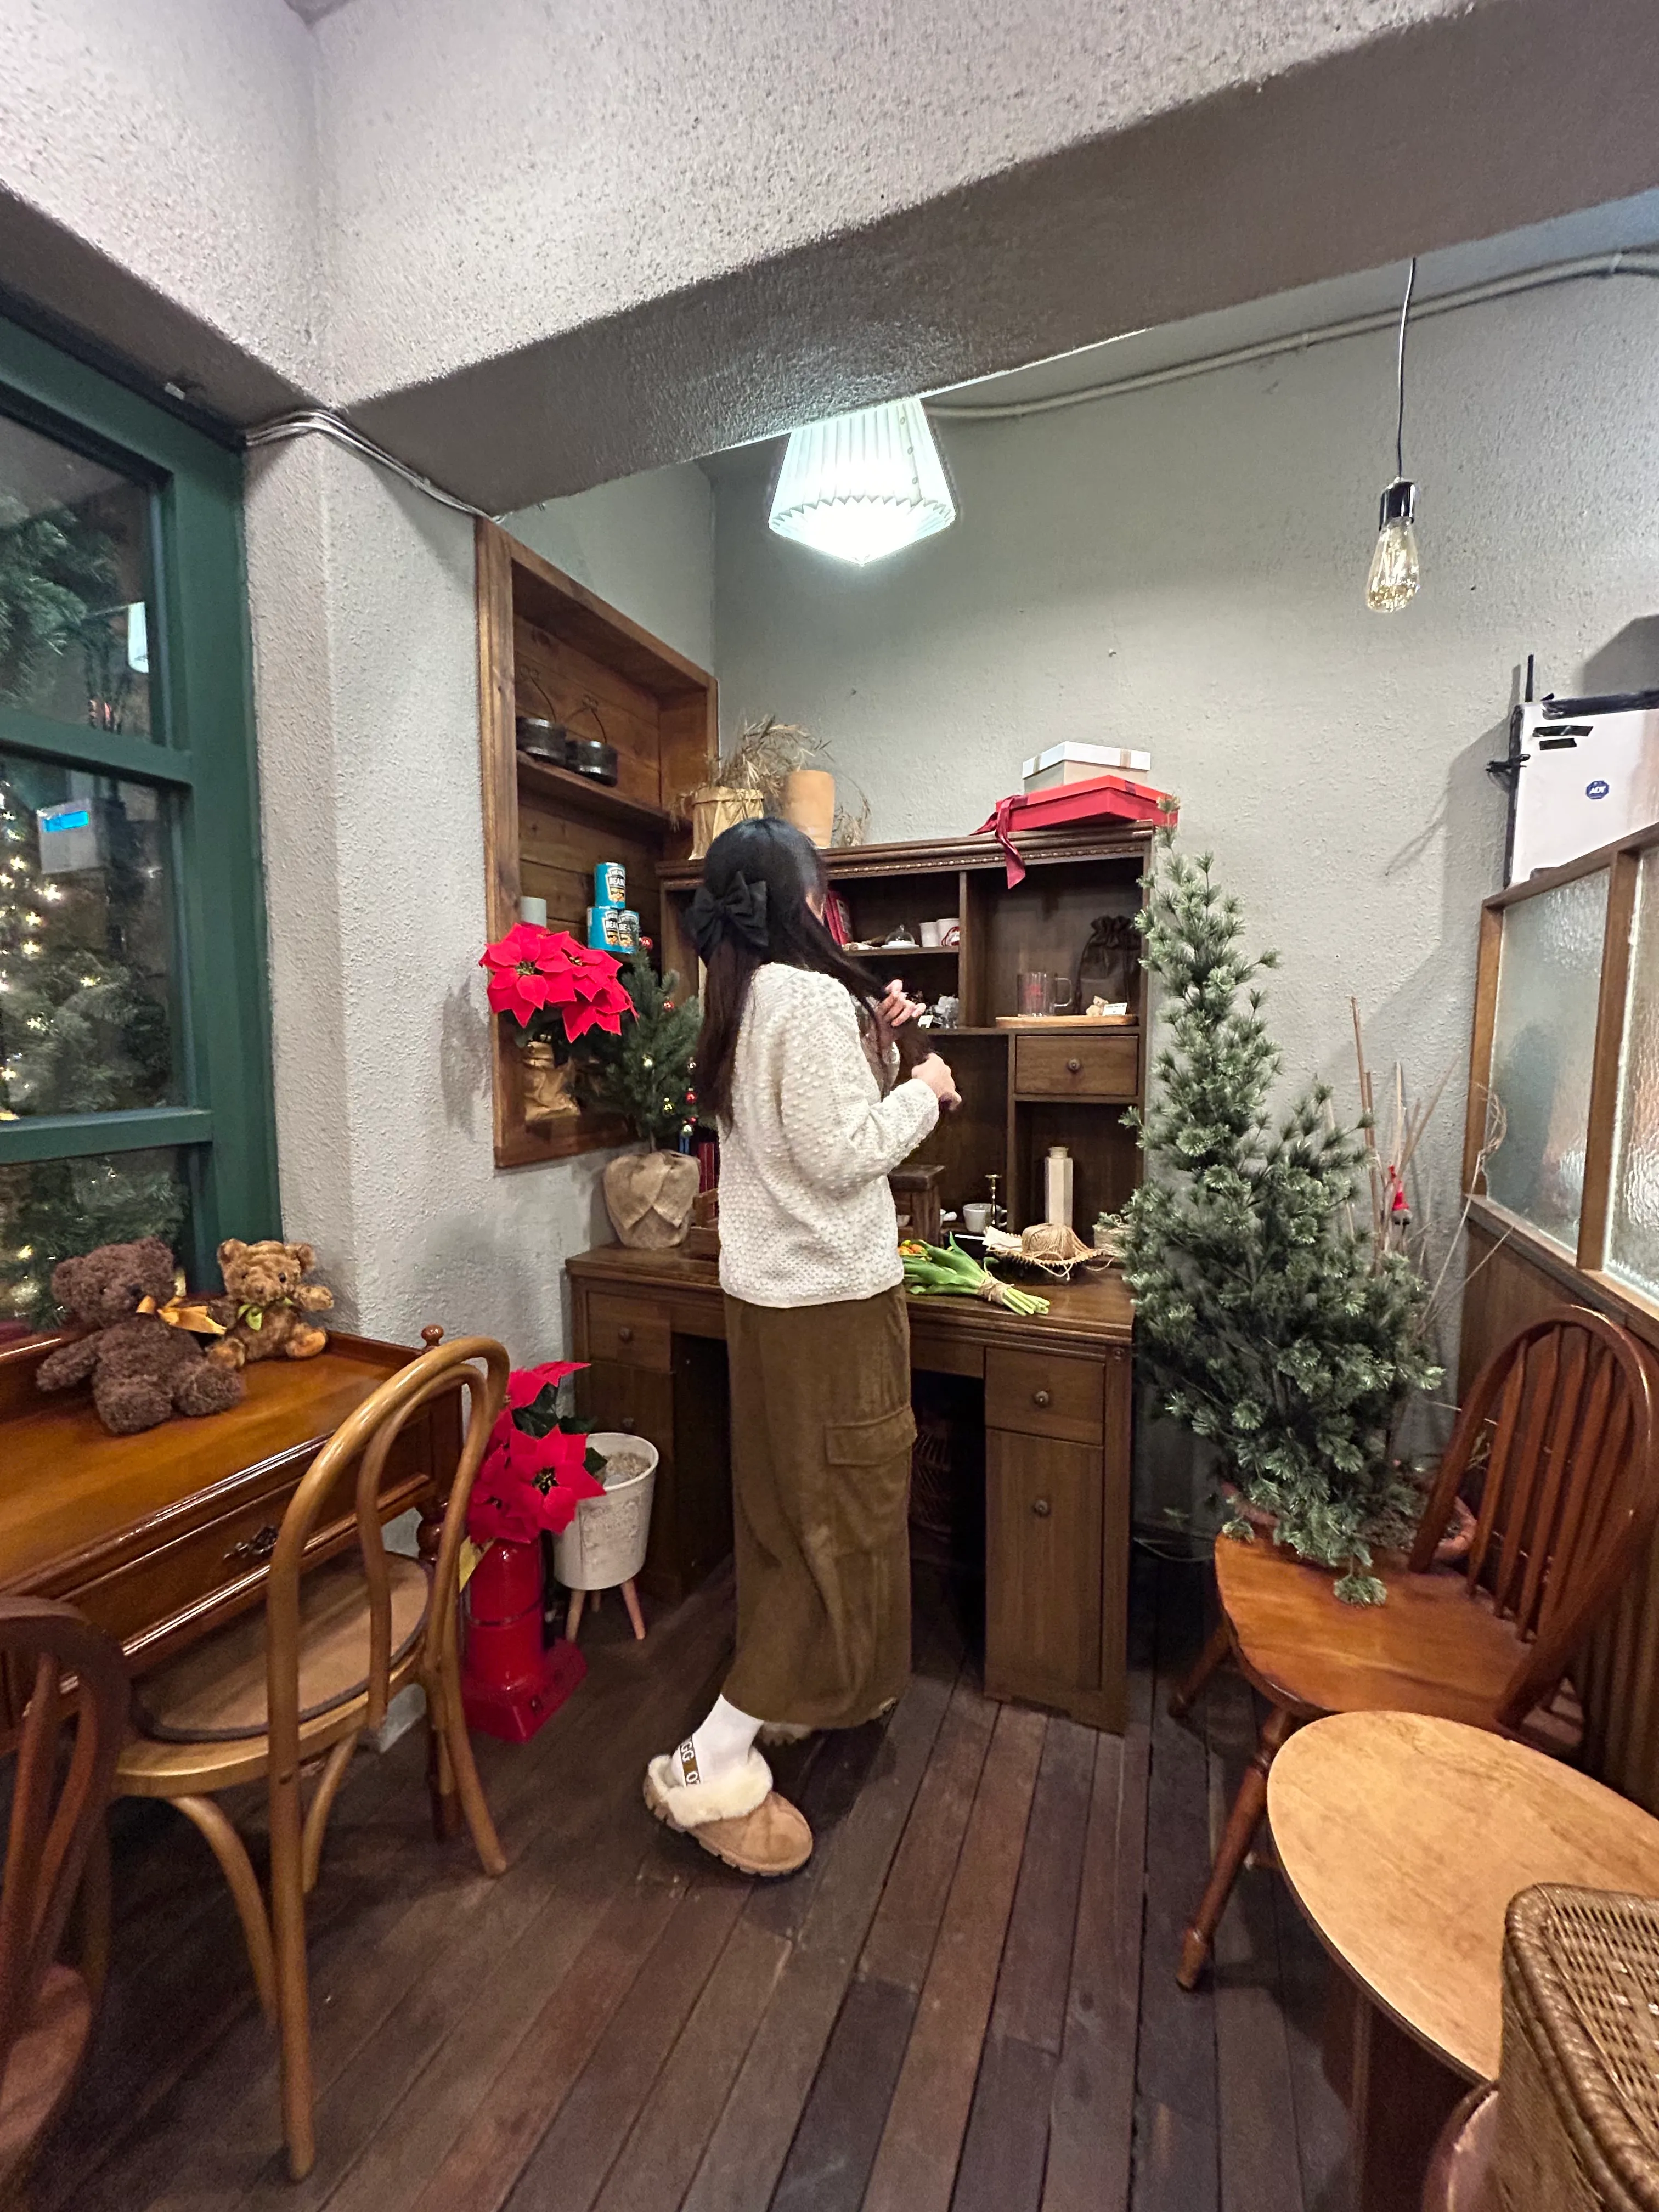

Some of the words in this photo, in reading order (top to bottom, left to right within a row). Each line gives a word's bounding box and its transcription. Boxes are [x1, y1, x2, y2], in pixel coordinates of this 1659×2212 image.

[609, 877, 625, 886] BEAN
[681, 1737, 695, 1762] GG
[686, 1771, 699, 1785] O
